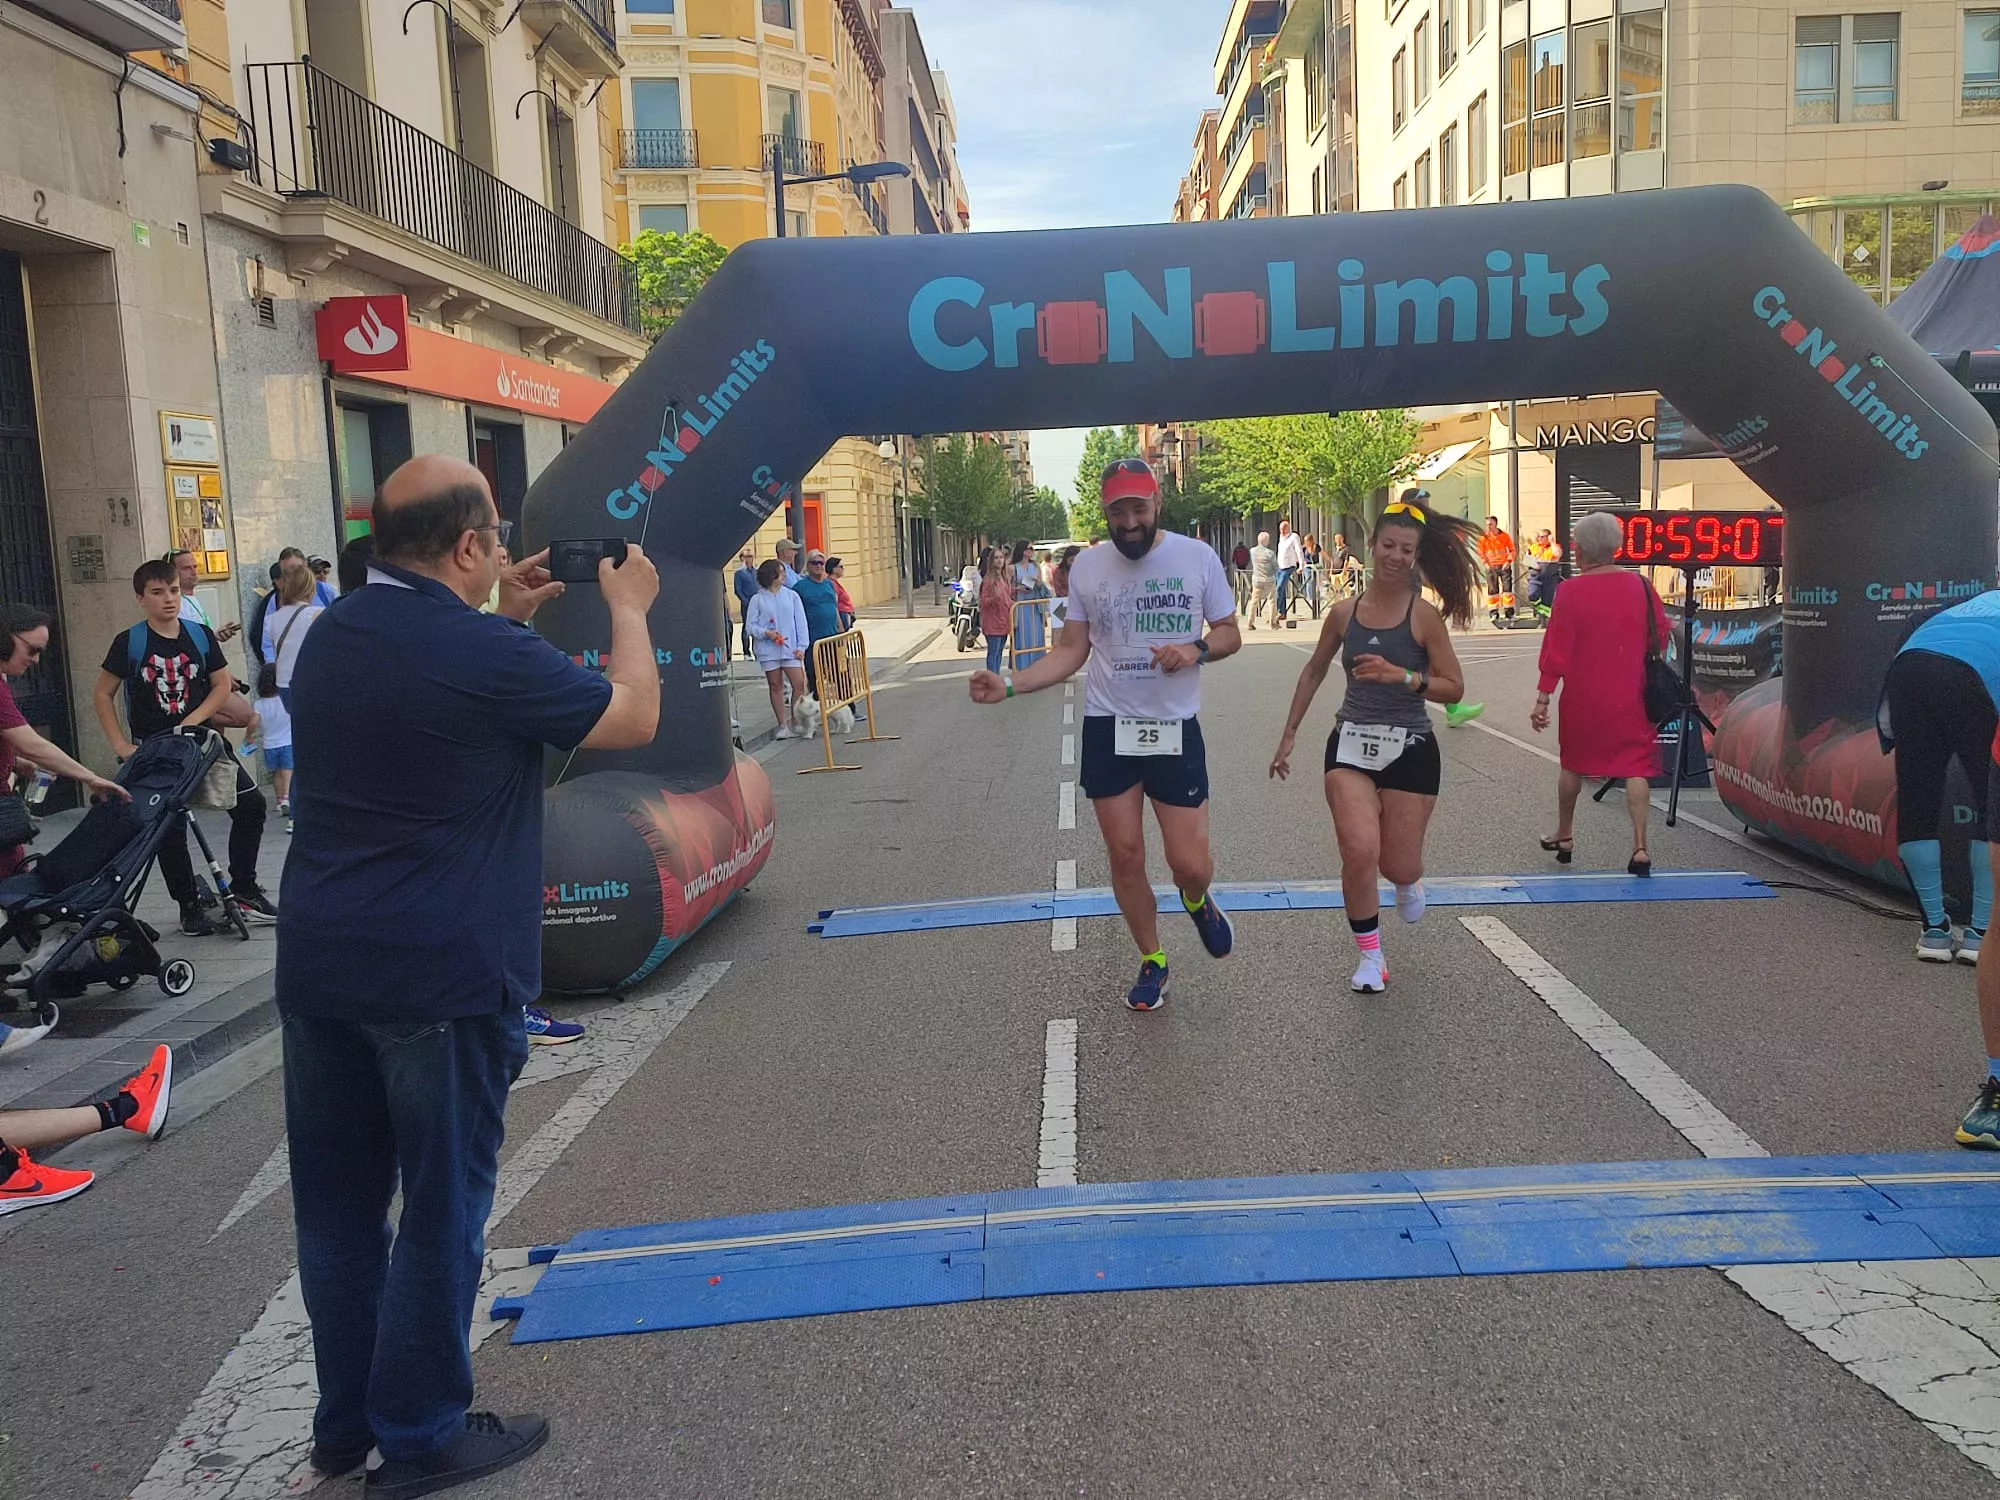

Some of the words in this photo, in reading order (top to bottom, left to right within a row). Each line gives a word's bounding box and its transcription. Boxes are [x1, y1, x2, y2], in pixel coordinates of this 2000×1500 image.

[33, 189, 49, 226] 2
[511, 369, 560, 408] Santander
[1614, 516, 1784, 560] 0:59:0
[1145, 577, 1184, 593] 5K-10K
[1136, 593, 1176, 611] CIUDAD
[1178, 593, 1194, 610] DE
[1135, 612, 1193, 633] HUESCA
[1137, 729, 1160, 743] 25
[1362, 743, 1380, 757] 15
[1714, 759, 1883, 836] www.cronolimits2020.com
[575, 912, 617, 924] deportivo
[592, 905, 598, 914] y
